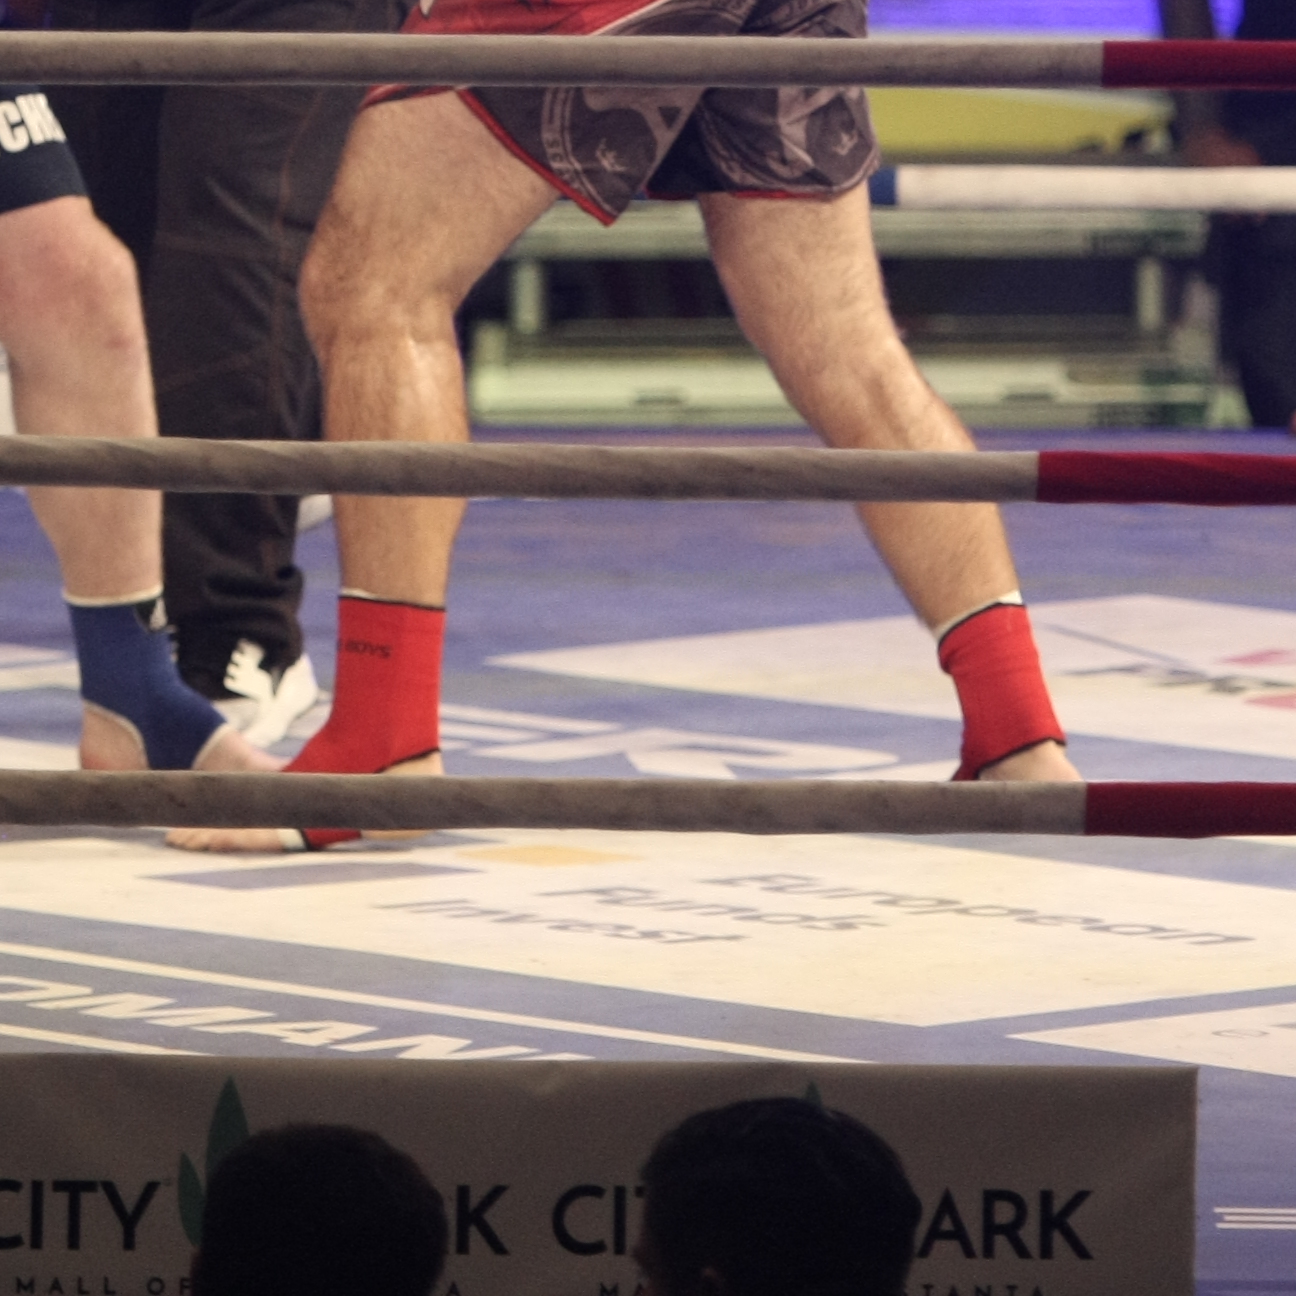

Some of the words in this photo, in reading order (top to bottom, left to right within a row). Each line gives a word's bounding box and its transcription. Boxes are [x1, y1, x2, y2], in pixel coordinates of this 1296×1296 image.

[371, 897, 757, 947] Invest
[536, 885, 899, 933] Funds
[698, 870, 1256, 946] European
[915, 1188, 1095, 1261] ARK
[15, 1276, 116, 1296] MALL
